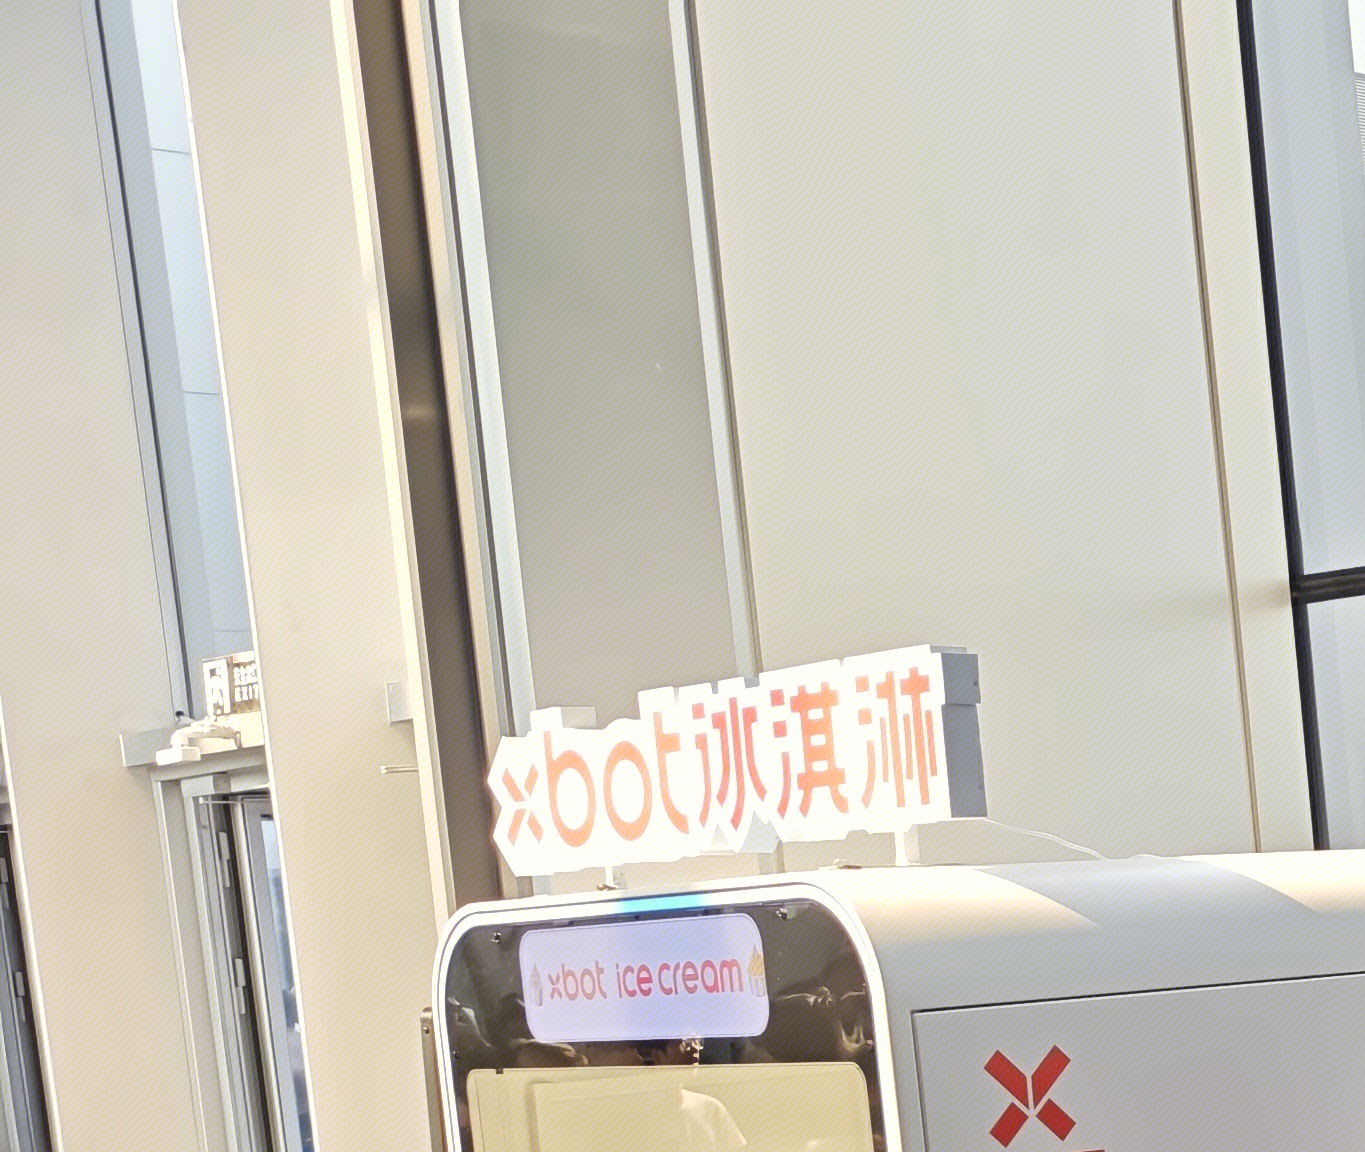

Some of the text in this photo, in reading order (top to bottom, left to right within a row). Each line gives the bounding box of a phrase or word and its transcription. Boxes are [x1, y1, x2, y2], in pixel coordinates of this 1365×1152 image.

[547, 957, 745, 1001] xbot ice cream
